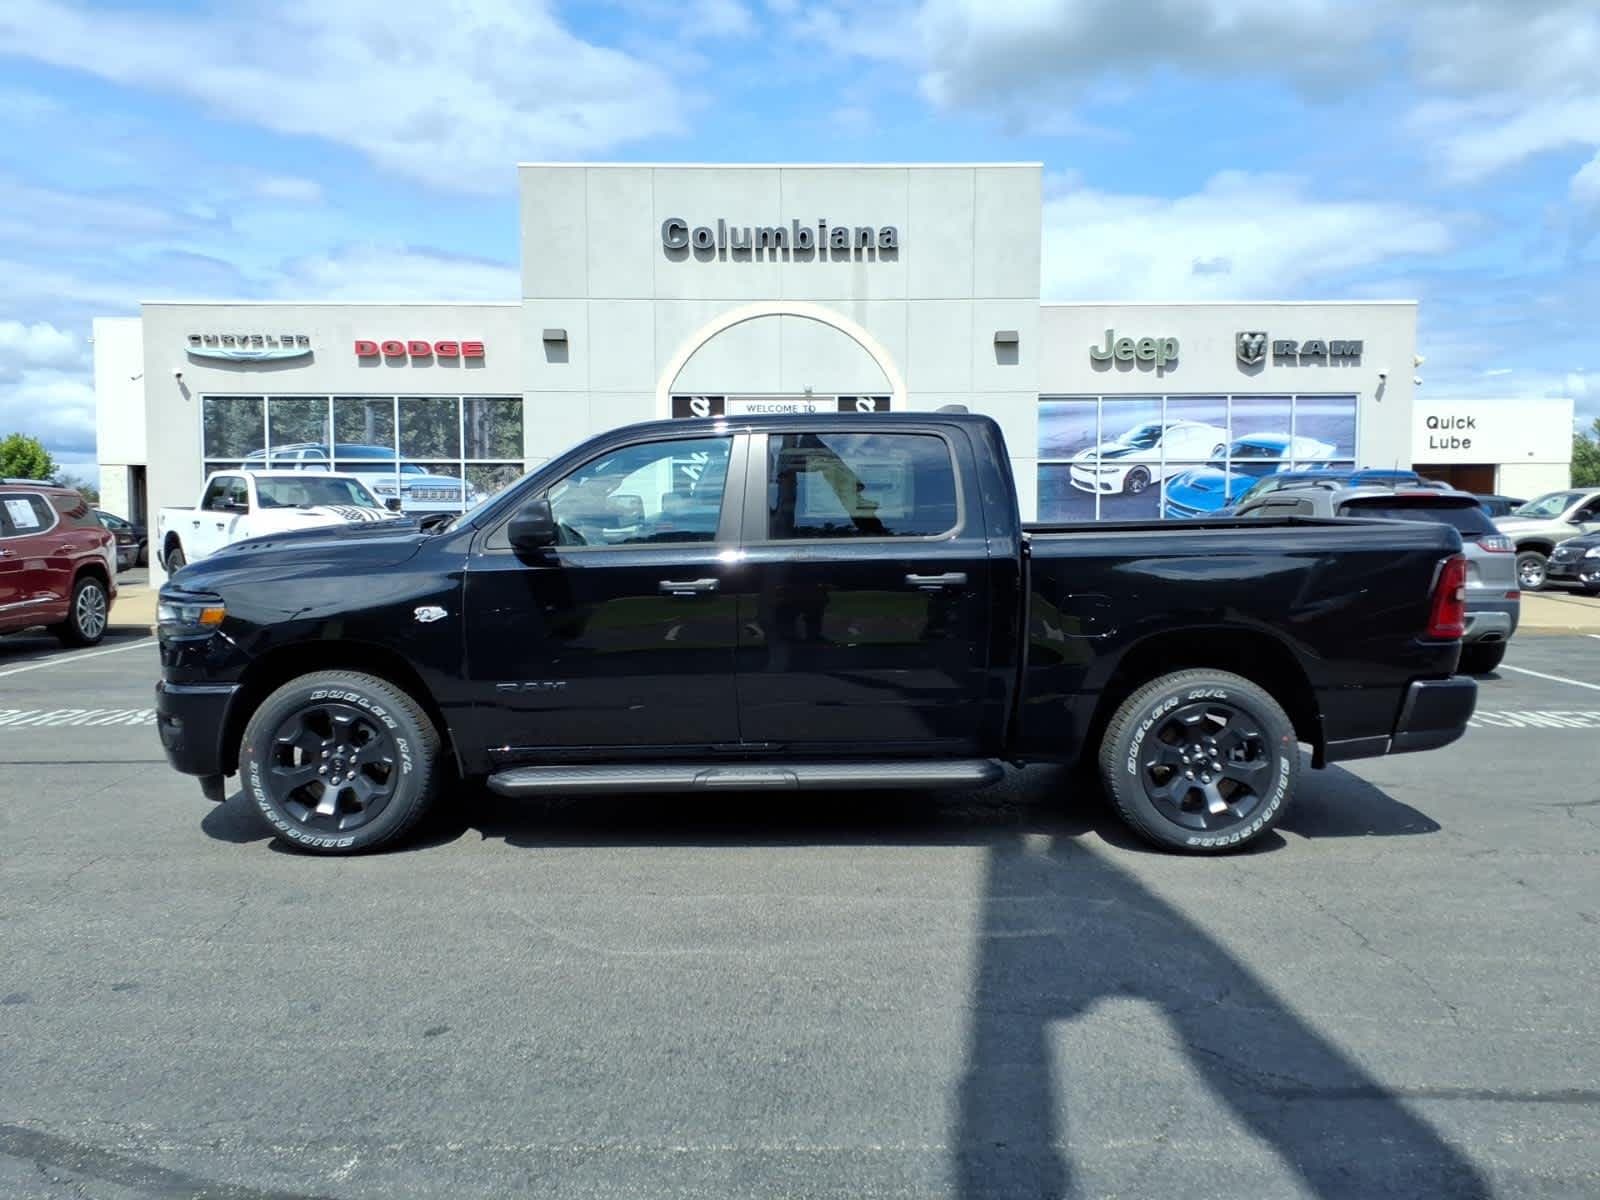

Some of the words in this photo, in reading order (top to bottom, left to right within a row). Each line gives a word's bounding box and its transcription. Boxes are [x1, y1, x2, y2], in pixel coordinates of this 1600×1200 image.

[661, 217, 900, 250] Columbiana
[187, 334, 311, 347] CHRYSLER
[355, 340, 485, 358] DODGE
[1089, 328, 1180, 367] Jeep
[1272, 339, 1363, 357] RAM
[746, 404, 799, 413] WELCOME
[803, 404, 817, 413] TO
[1426, 415, 1476, 430] Quick
[1429, 435, 1472, 449] Lube
[309, 689, 398, 729] DUELER
[1127, 696, 1179, 776] DUELER
[249, 760, 356, 848] BRIDGESTONE
[1187, 756, 1290, 847] BRIDGESTONE
